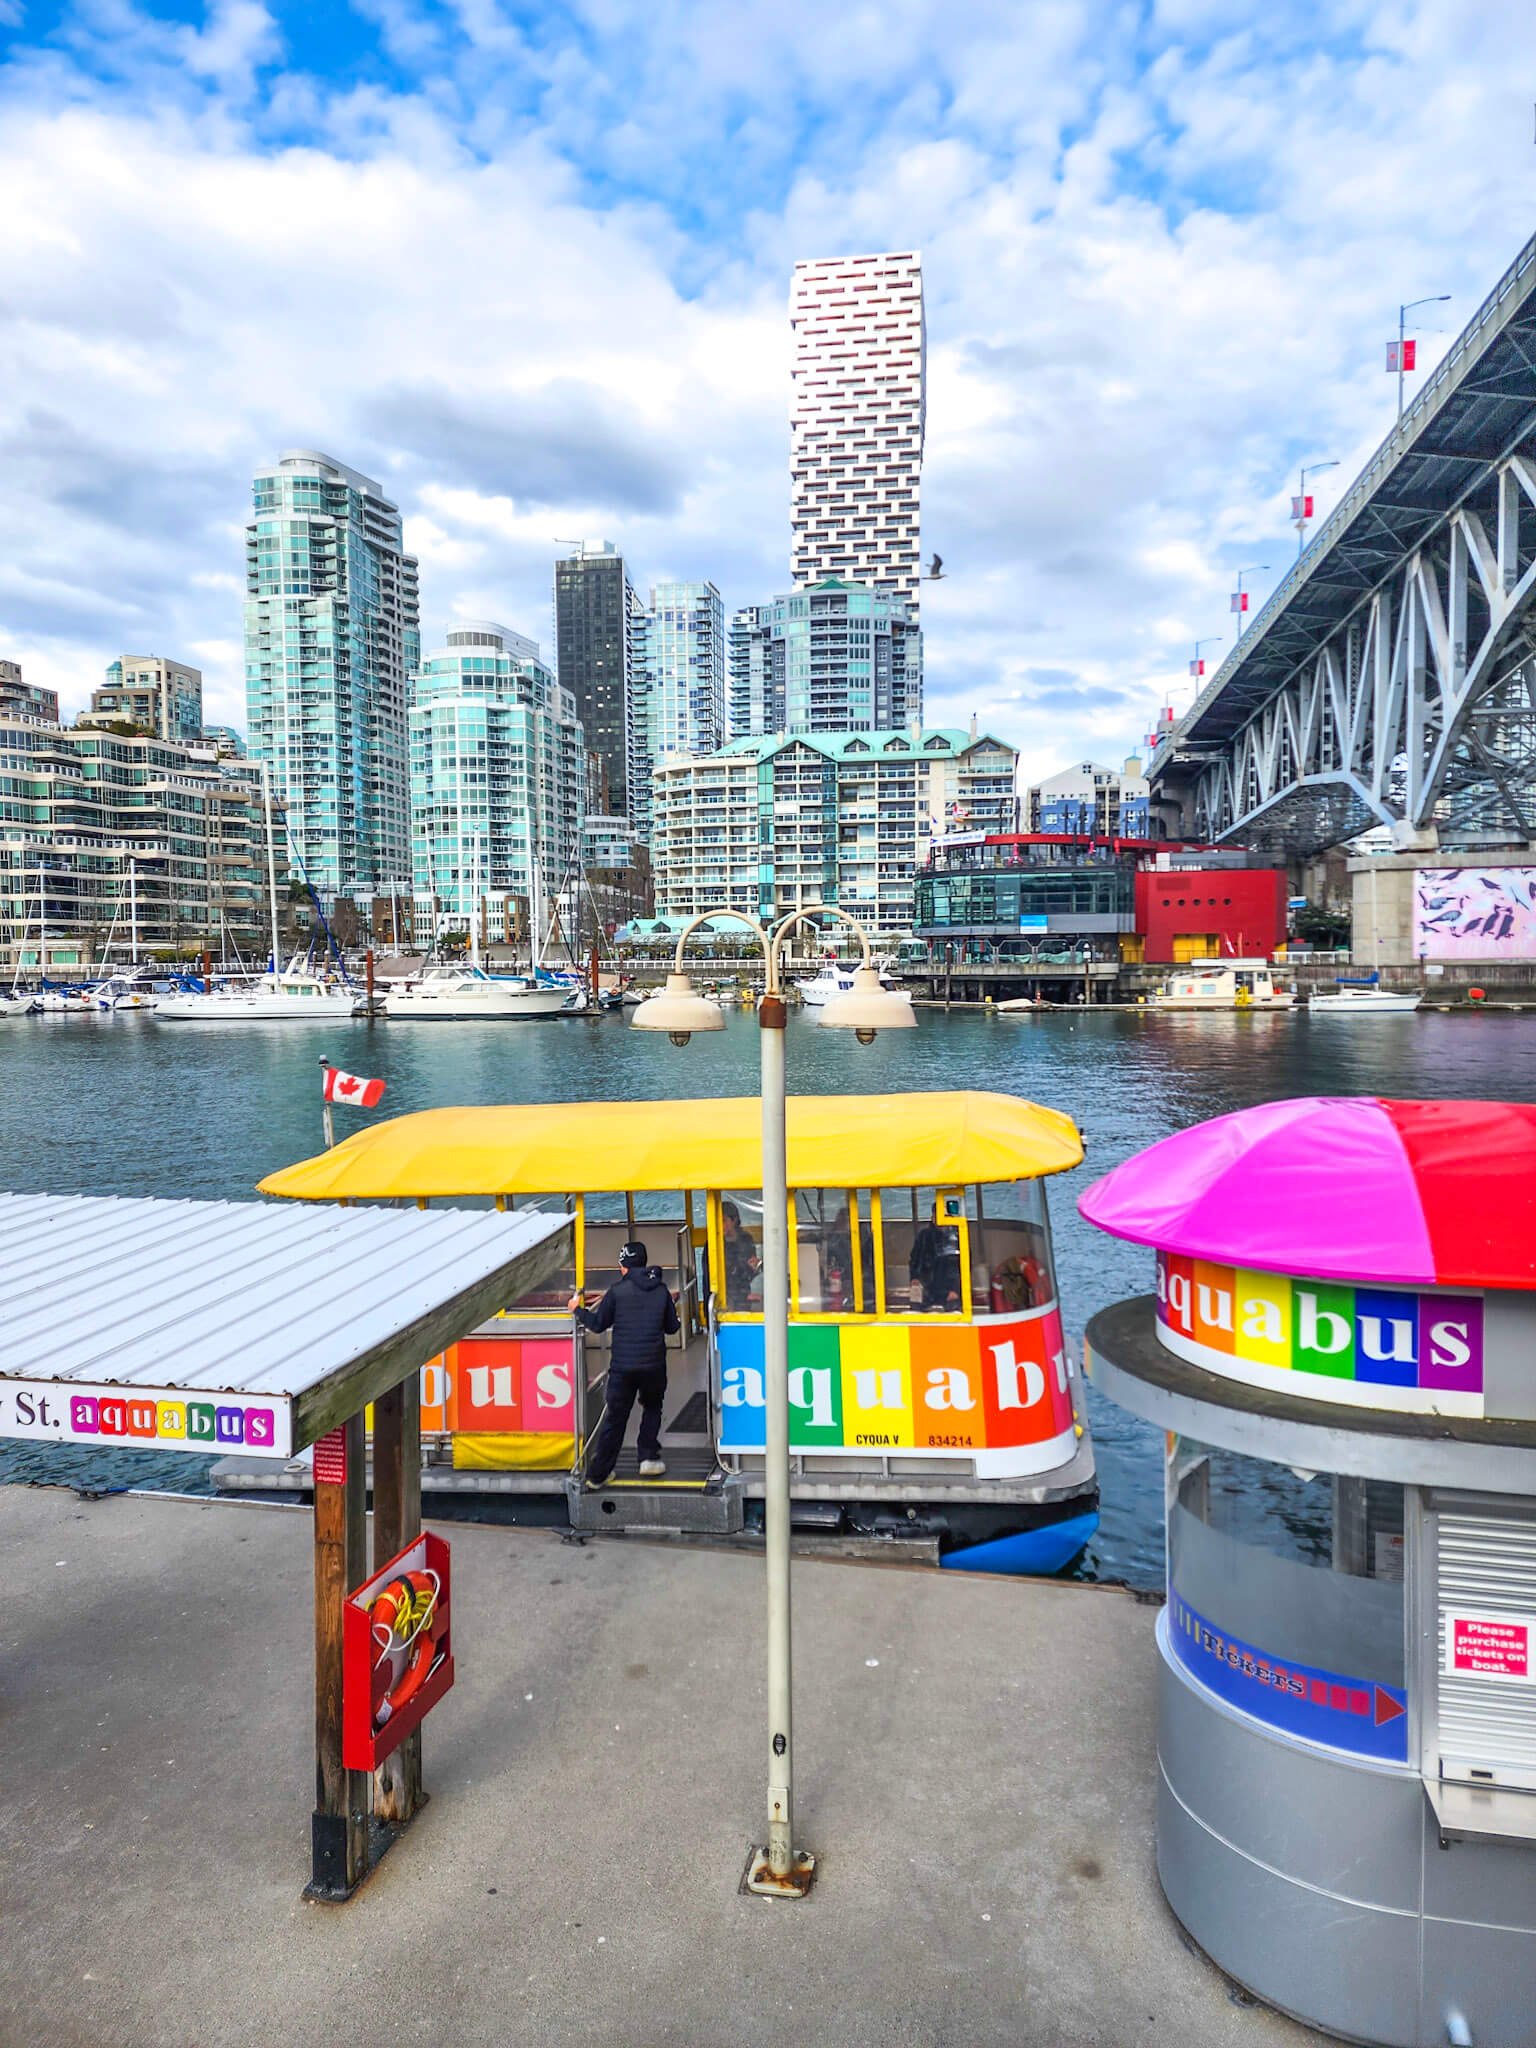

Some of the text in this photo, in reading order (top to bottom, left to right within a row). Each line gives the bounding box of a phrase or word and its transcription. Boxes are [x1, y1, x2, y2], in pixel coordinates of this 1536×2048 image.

[15, 1391, 269, 1440] St. aquabus
[855, 1434, 899, 1446] CYQUA V
[928, 1435, 972, 1447] 834214
[1467, 1623, 1515, 1638] Please
[1457, 1635, 1525, 1651] purchase
[1455, 1647, 1526, 1663] tickets on
[1471, 1659, 1511, 1673] boat.
